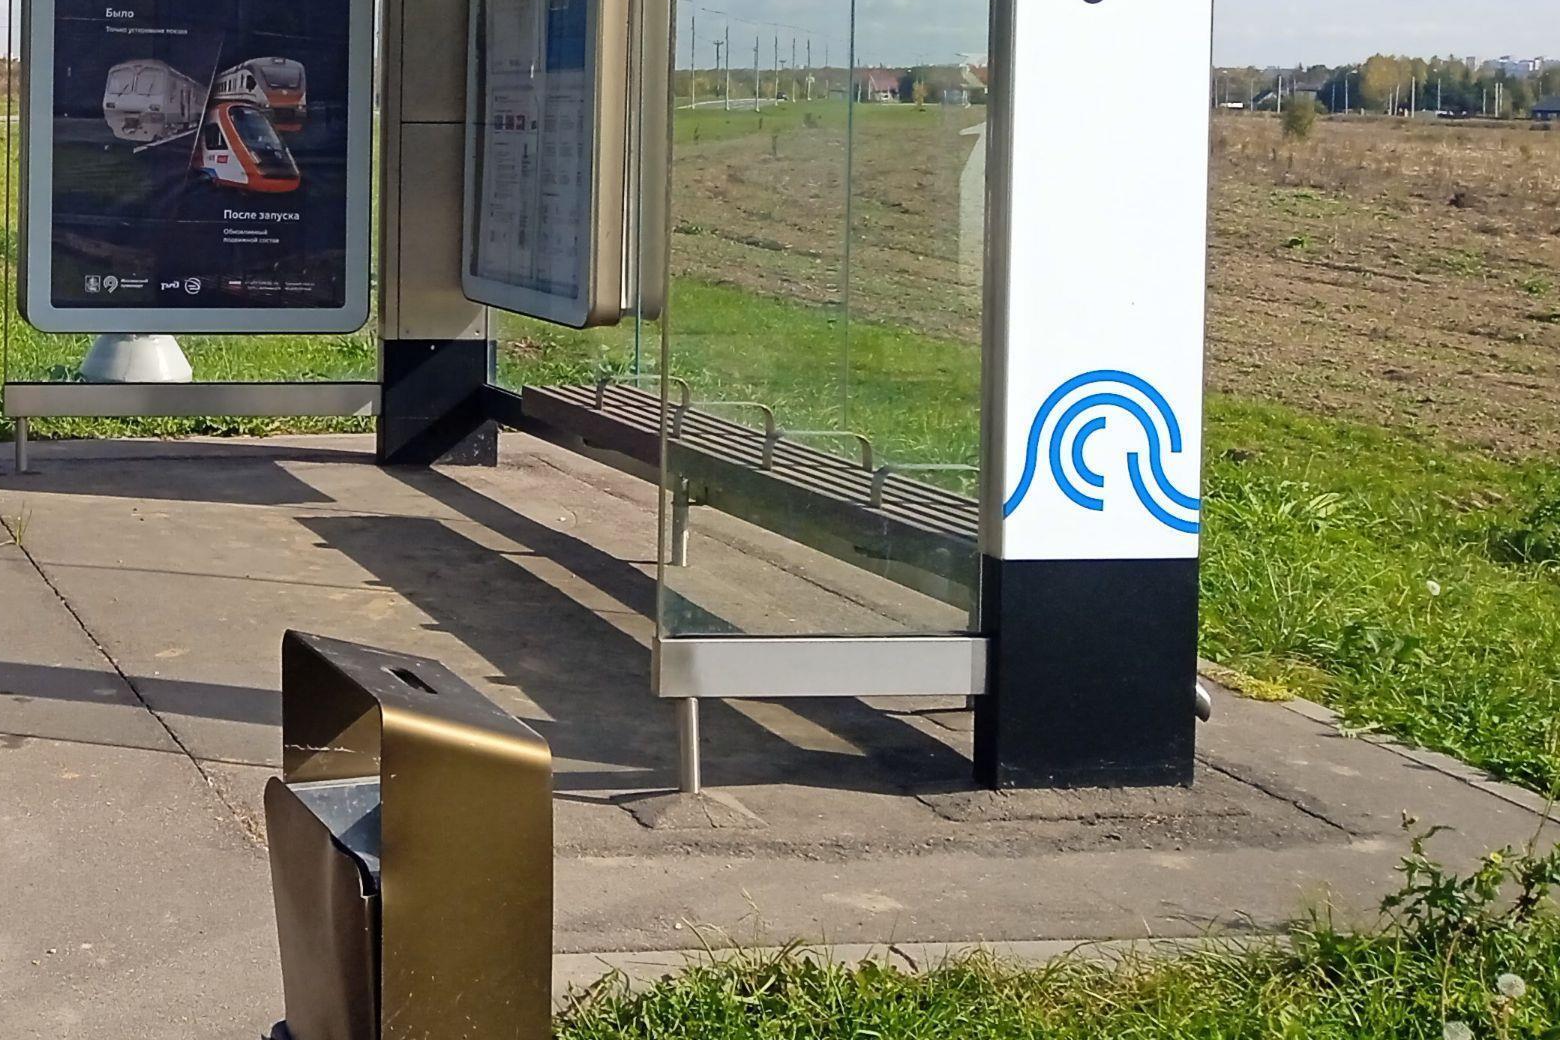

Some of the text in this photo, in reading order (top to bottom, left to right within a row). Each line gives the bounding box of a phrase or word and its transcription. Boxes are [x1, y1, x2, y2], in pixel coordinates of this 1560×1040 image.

[105, 7, 135, 18] Было
[223, 209, 300, 222] После запуска
